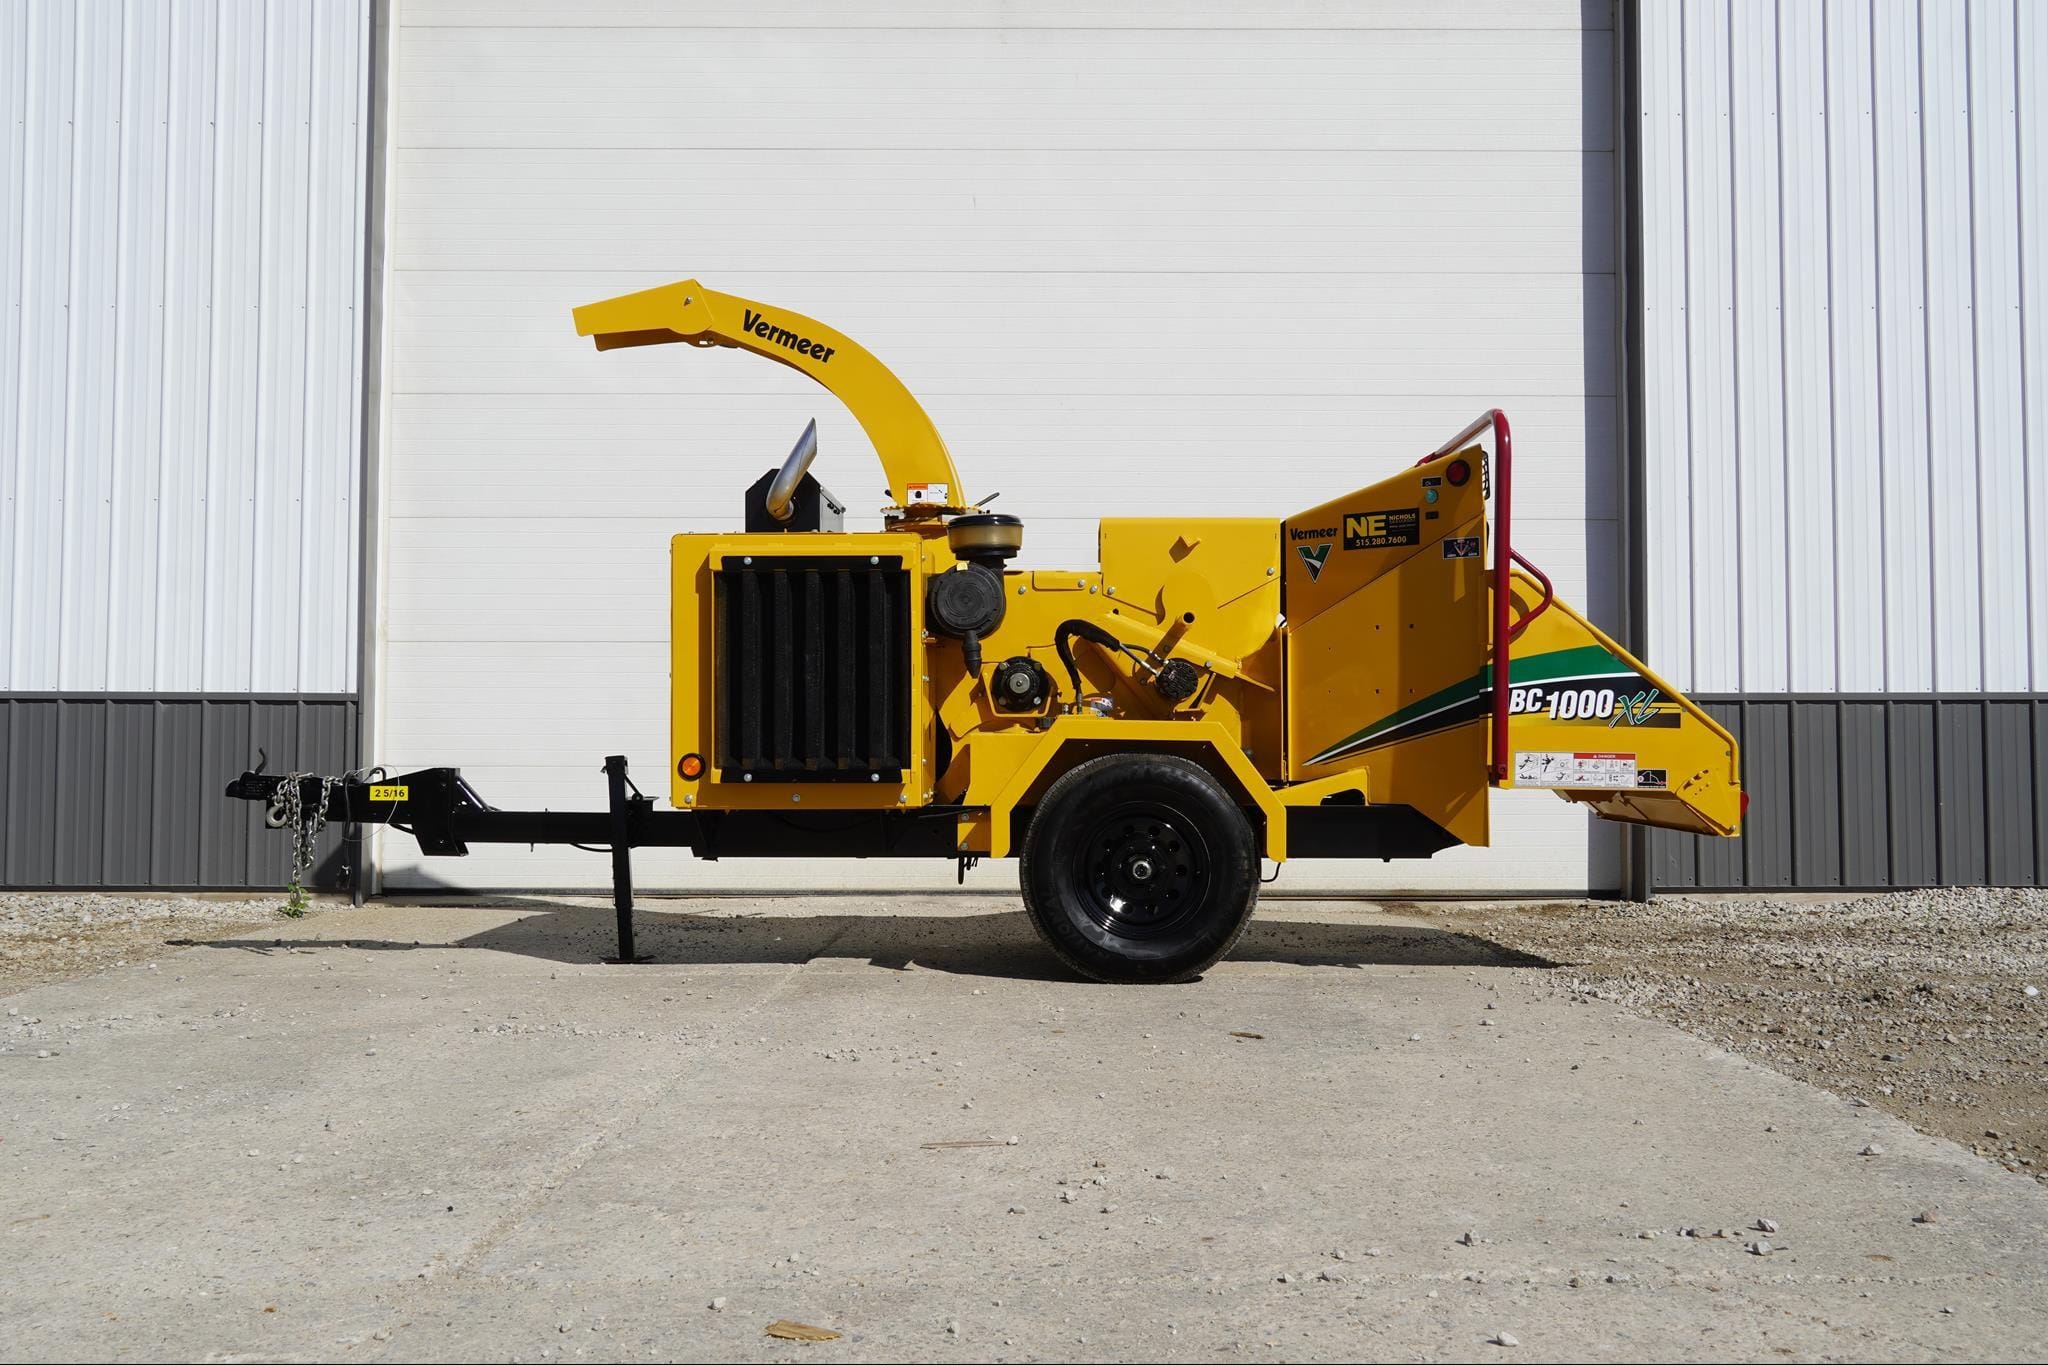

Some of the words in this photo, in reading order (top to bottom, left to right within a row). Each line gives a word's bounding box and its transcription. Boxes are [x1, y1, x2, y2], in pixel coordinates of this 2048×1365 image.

[742, 308, 835, 363] Vermeer
[1389, 513, 1416, 521] NICHOLS
[1346, 515, 1386, 538] NE
[1290, 527, 1338, 541] Vermeer
[1355, 536, 1407, 547] 515.280.7600
[1509, 688, 1543, 713] BC
[1546, 689, 1614, 719] 1000
[1609, 688, 1660, 728] XL
[375, 789, 381, 797] 2
[383, 789, 405, 798] 5/16
